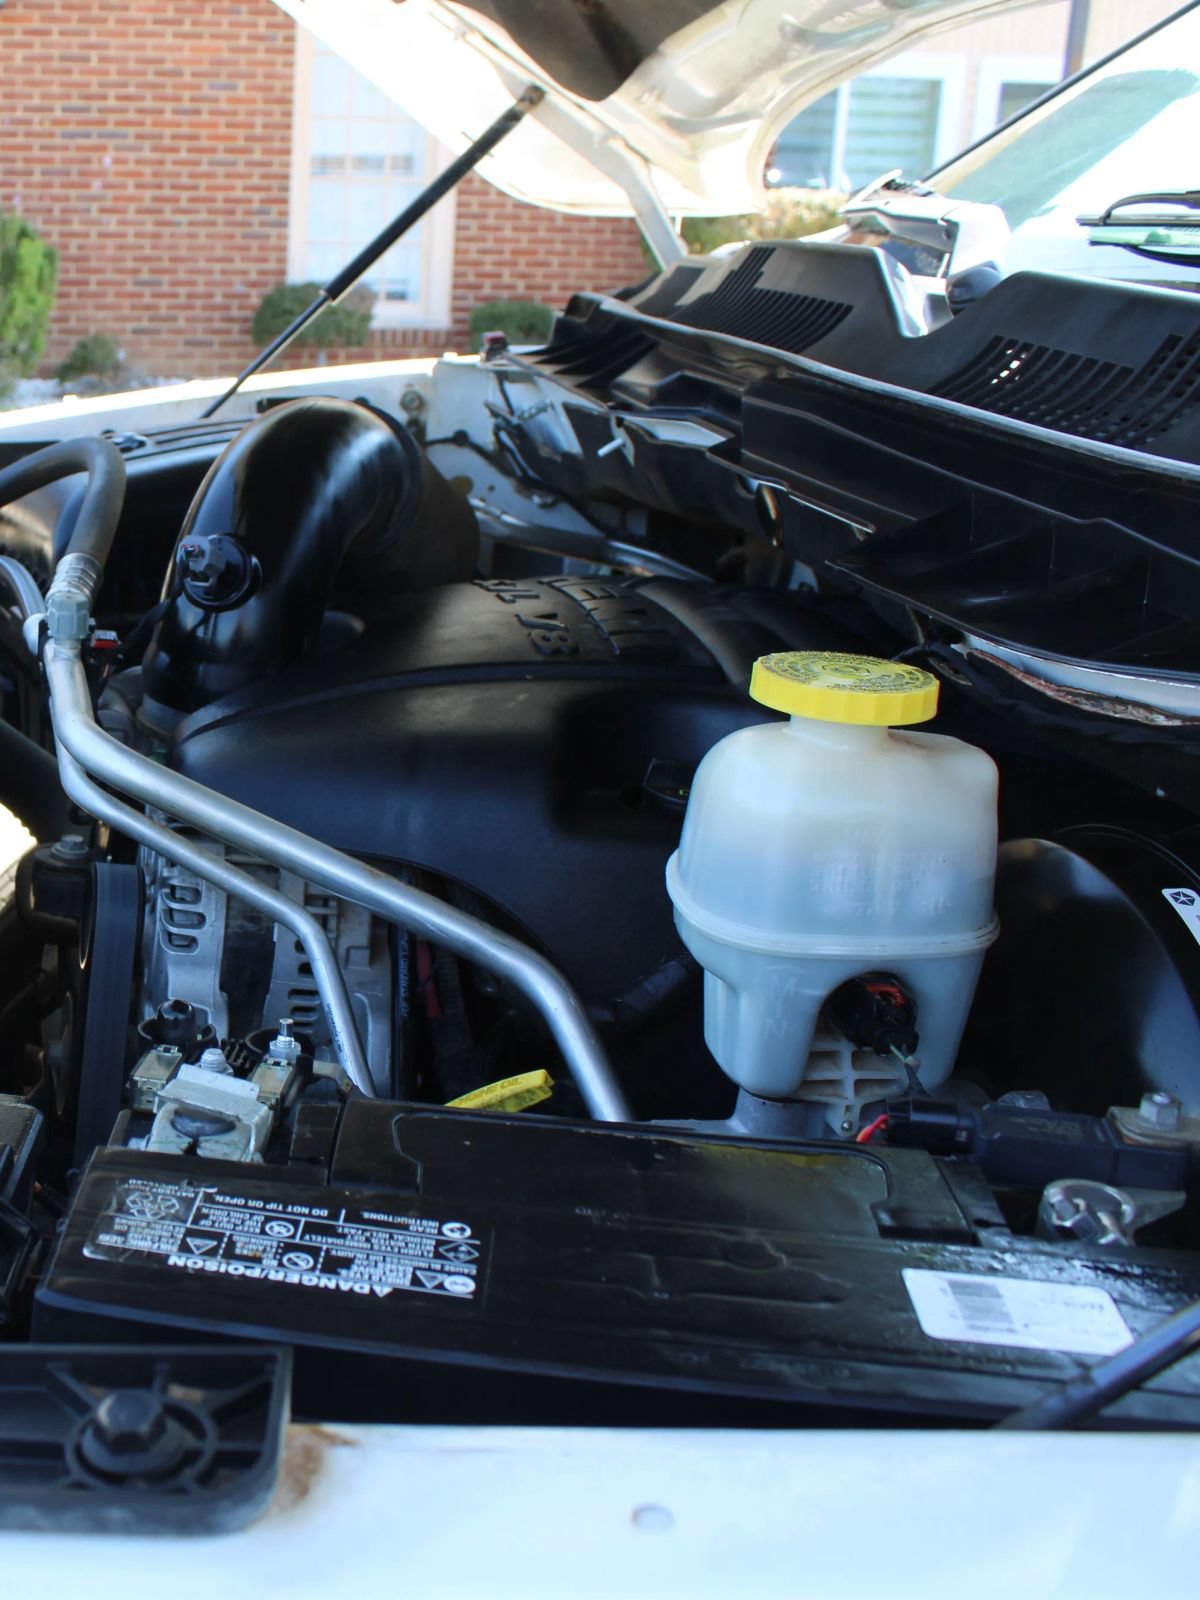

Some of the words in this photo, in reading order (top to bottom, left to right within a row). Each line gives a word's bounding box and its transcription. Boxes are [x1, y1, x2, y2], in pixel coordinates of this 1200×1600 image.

[212, 1193, 245, 1205] OPEN.
[247, 1199, 264, 1207] OR
[265, 1201, 283, 1210] TIP
[284, 1202, 309, 1215] NOT
[309, 1206, 328, 1217] DO
[200, 1207, 250, 1219] CHILDREN
[359, 1210, 439, 1227] INSTRUCTIONS.
[302, 1233, 371, 1249] IMMEDIATELY
[167, 1254, 372, 1294] DANGER/POISON
